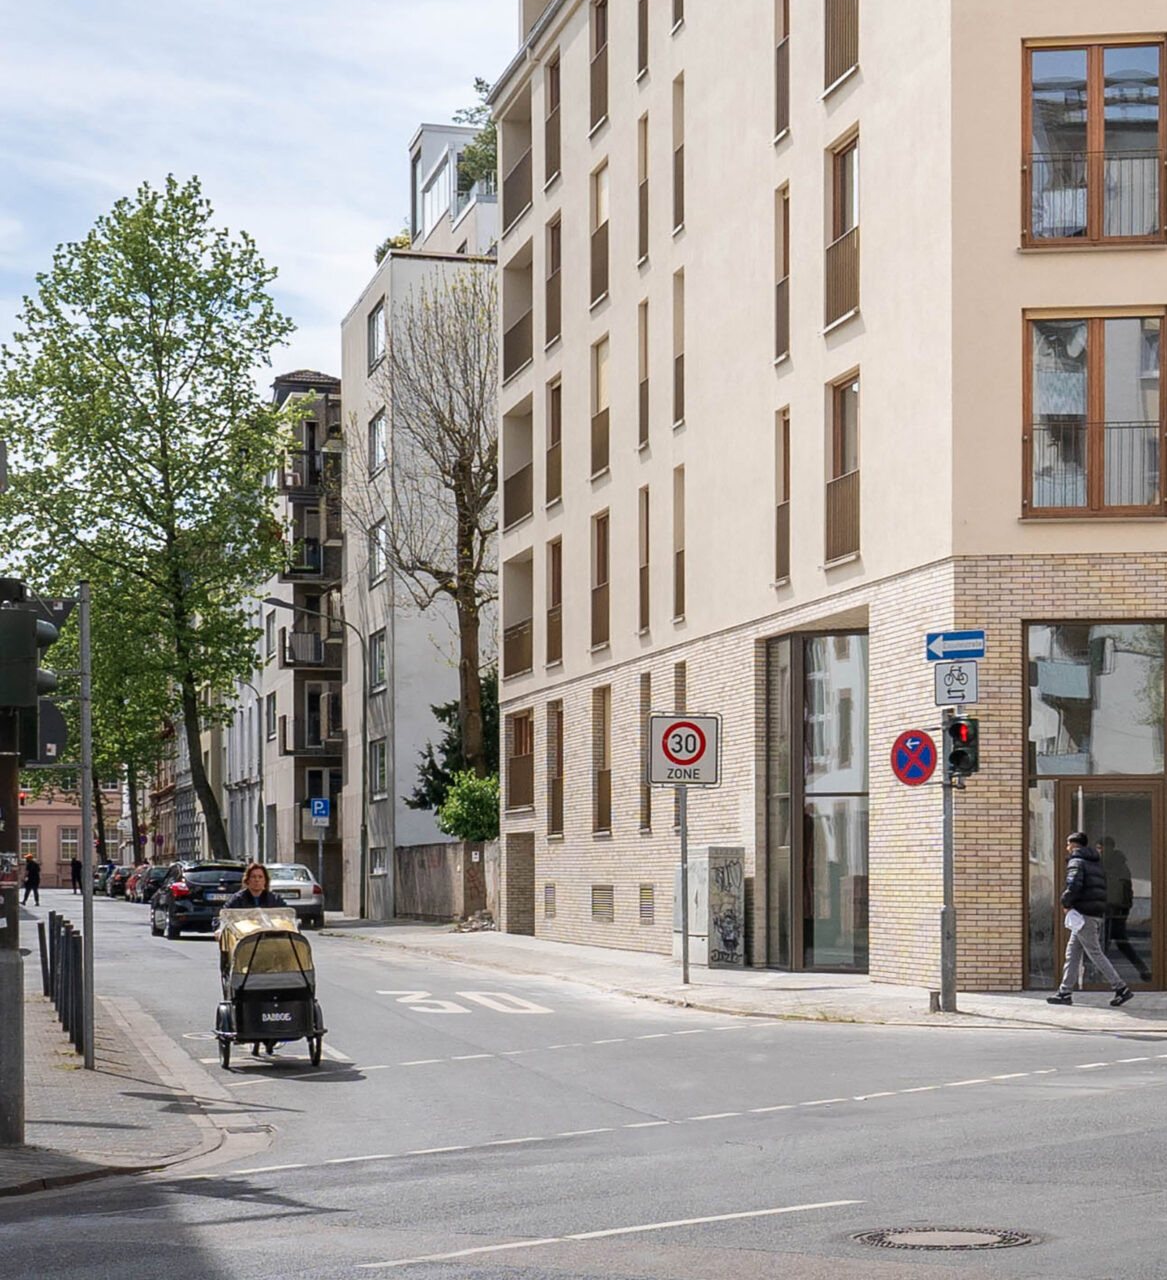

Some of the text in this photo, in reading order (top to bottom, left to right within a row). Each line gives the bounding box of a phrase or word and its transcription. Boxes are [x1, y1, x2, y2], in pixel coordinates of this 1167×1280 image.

[671, 733, 697, 754] 30
[667, 768, 701, 780] ZONE
[376, 990, 555, 1014] 30
